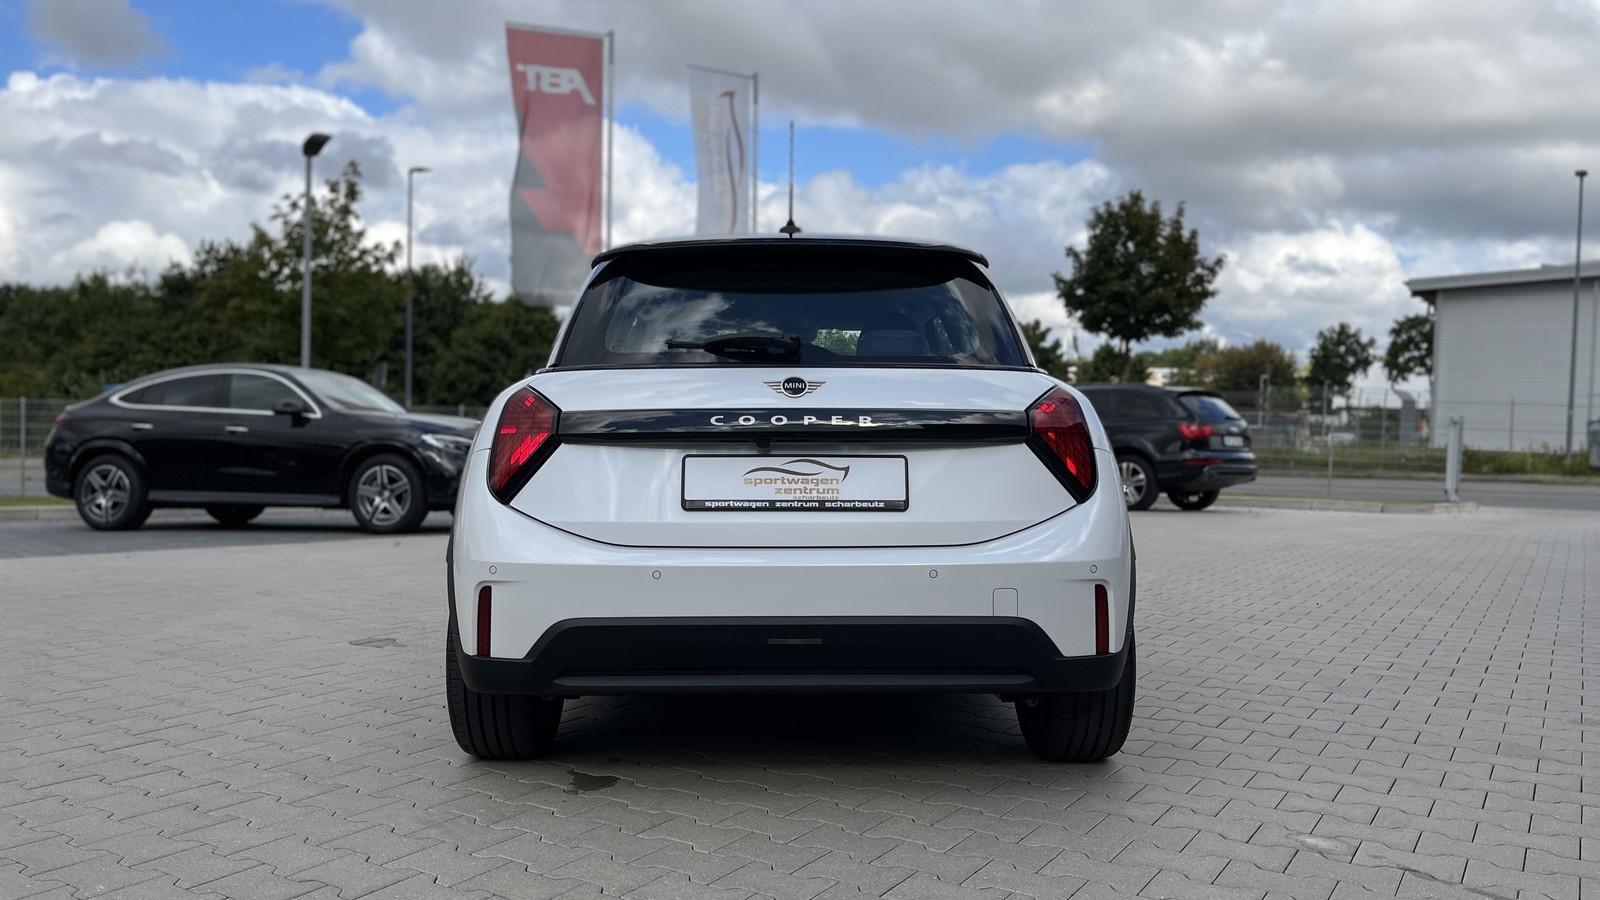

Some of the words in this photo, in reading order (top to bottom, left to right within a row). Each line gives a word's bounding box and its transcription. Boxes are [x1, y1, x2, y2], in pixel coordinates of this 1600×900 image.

[710, 415, 874, 427] COOPER
[743, 476, 840, 486] sportwagen
[774, 486, 840, 495] zentrum
